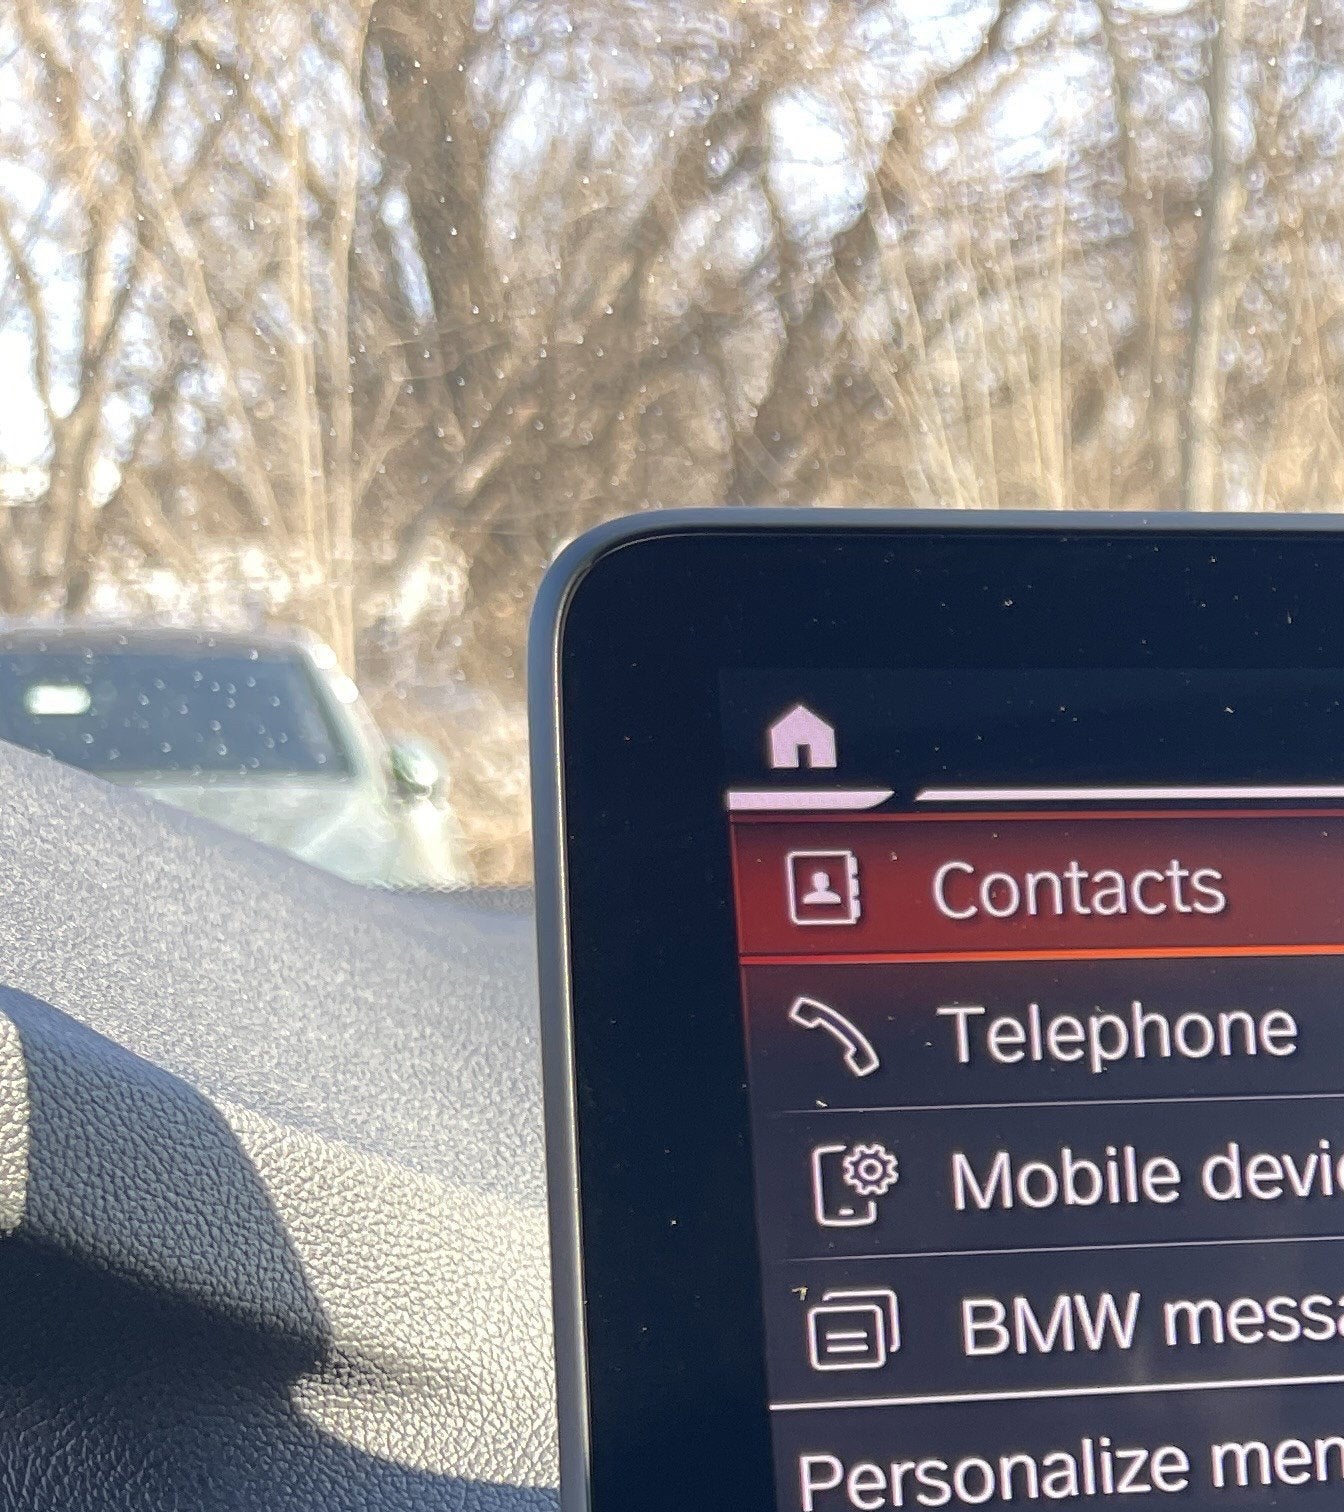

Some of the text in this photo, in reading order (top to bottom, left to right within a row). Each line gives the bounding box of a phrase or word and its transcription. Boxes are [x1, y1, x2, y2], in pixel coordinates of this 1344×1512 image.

[932, 859, 1226, 919] Contacts
[937, 1000, 1298, 1074] Telephone
[952, 1145, 1181, 1211] Mobile
[962, 1290, 1141, 1356] BMW
[799, 1436, 1190, 1512] Personalize
